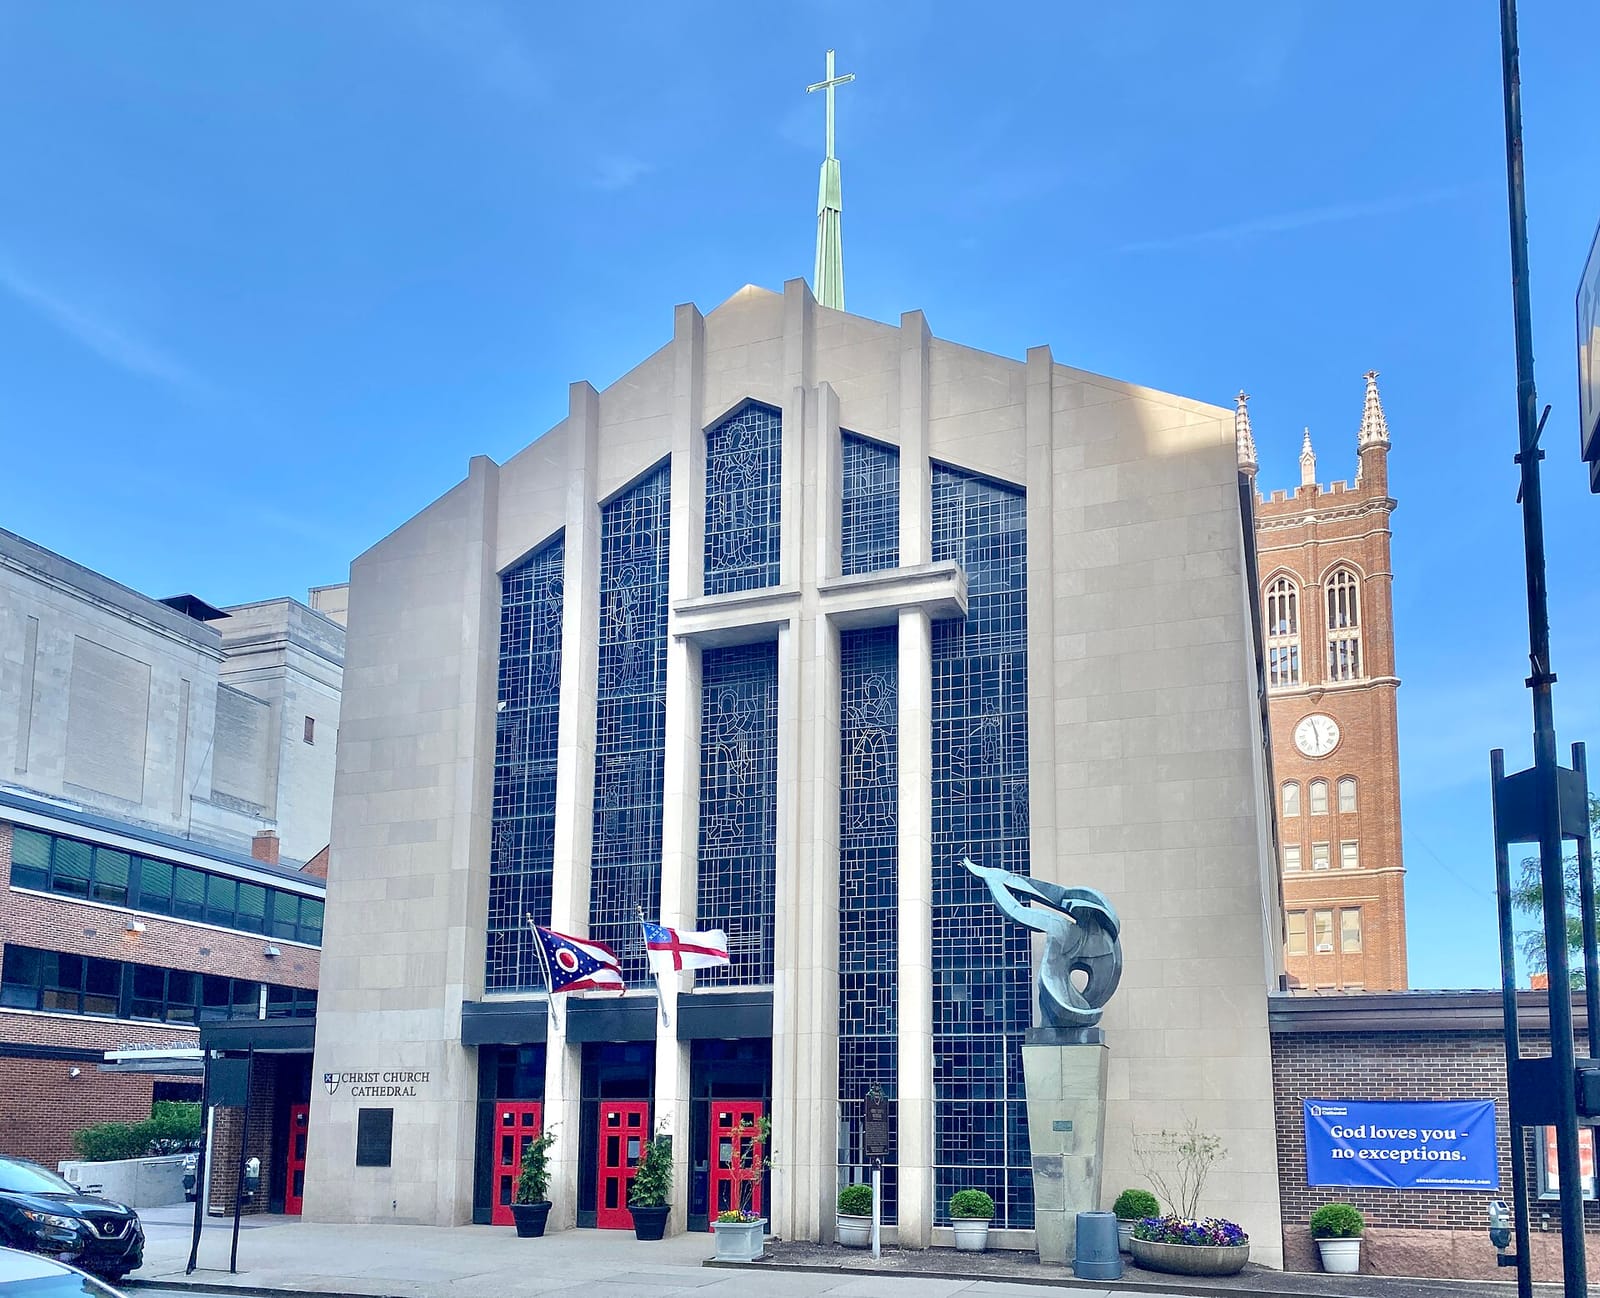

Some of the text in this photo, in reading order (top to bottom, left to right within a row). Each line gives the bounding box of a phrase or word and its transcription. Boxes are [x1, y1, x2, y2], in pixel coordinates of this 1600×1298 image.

[341, 1072, 430, 1083] CHRIST CHURCH
[351, 1086, 416, 1097] CATHEDRAL
[1330, 1125, 1366, 1139] God
[1370, 1125, 1417, 1139] loves
[1420, 1129, 1457, 1143] you
[1331, 1146, 1467, 1164] no exceptions.
